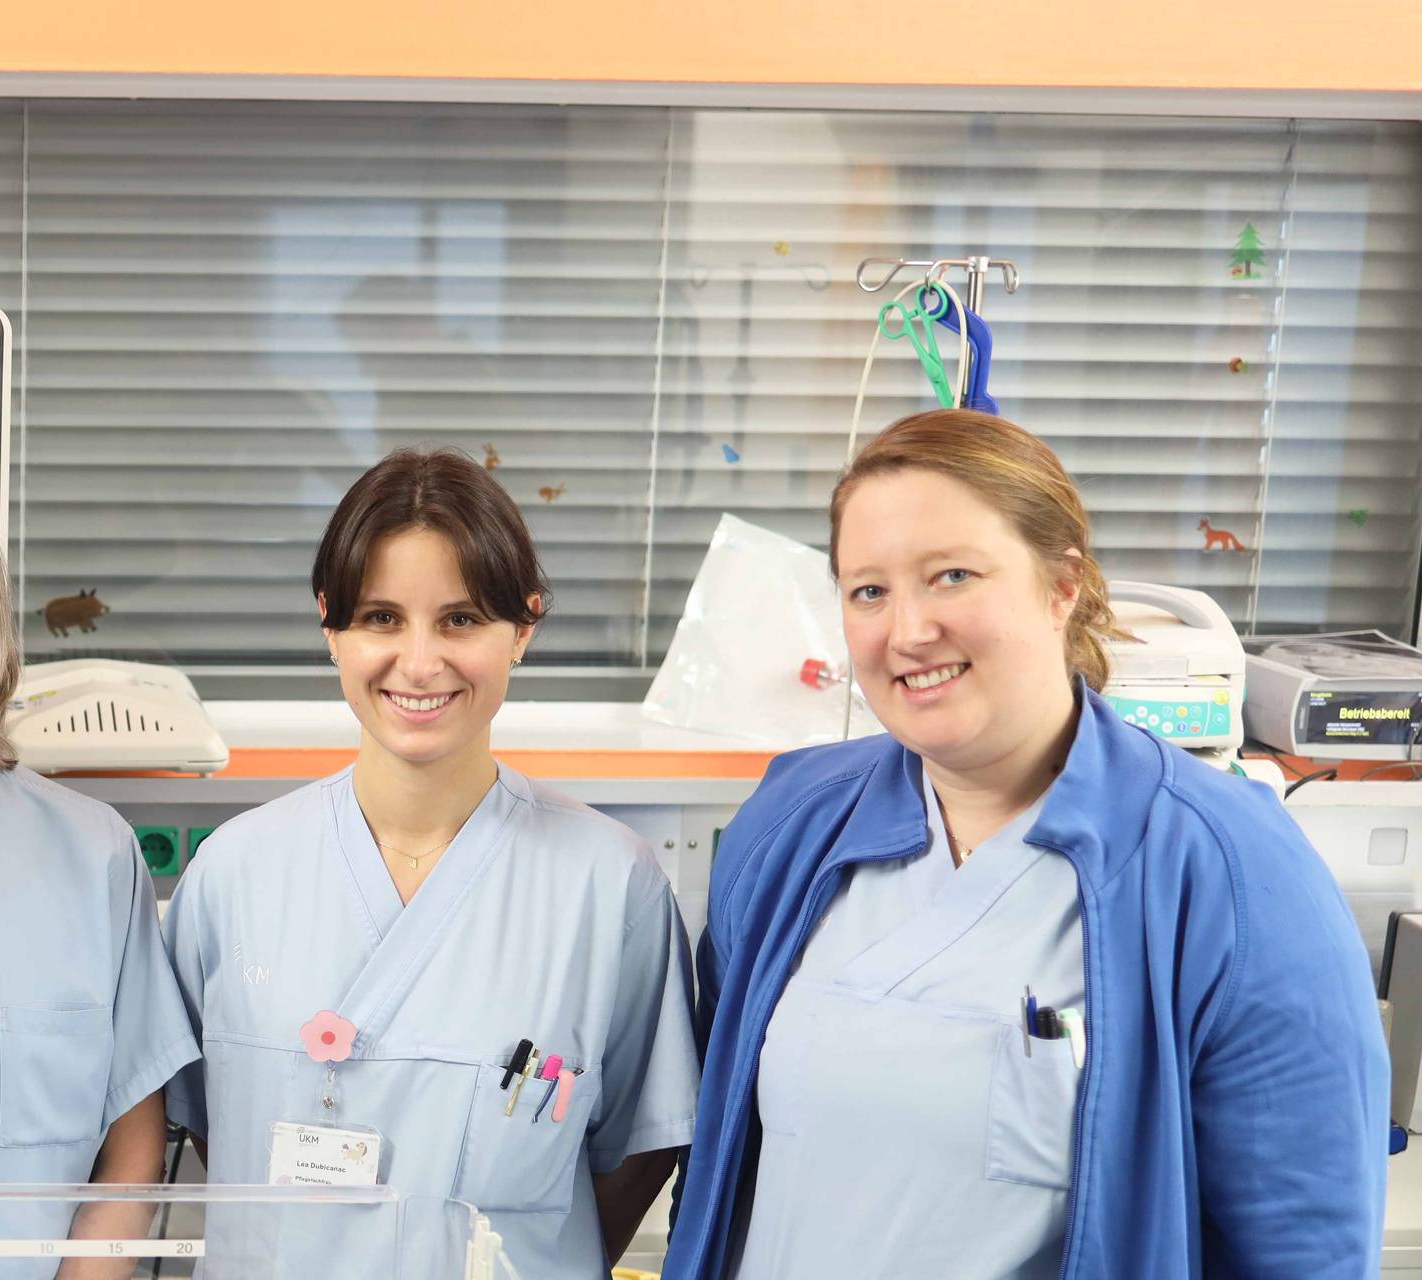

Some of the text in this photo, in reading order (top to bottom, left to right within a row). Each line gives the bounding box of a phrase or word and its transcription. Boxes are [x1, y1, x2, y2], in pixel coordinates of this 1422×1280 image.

[1339, 707, 1410, 720] Betriebsbereit
[243, 965, 270, 985] KM
[299, 1134, 319, 1145] UKM
[296, 1160, 347, 1173] Lea Dubicanac
[39, 1243, 54, 1253] 10
[108, 1242, 123, 1254] 15
[176, 1242, 193, 1254] 20
